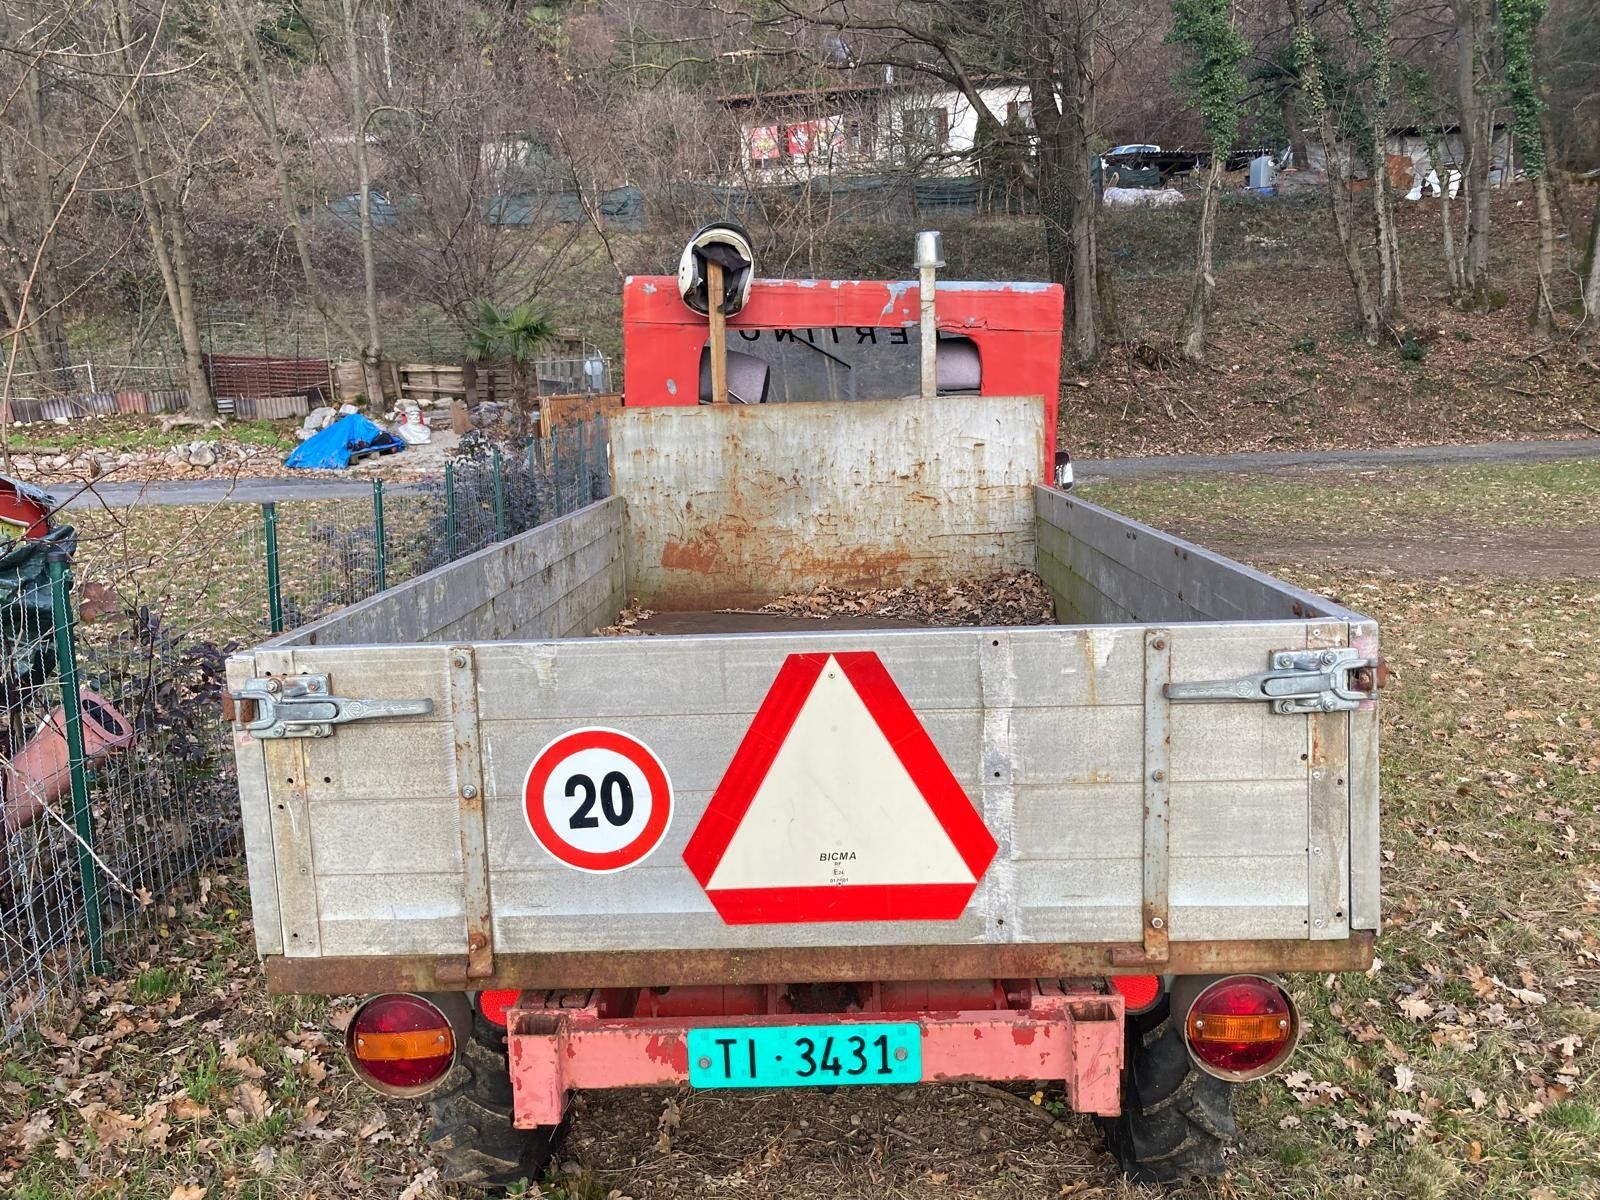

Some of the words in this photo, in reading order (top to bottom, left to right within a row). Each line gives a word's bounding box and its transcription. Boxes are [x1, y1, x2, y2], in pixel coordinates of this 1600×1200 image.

[565, 771, 634, 829] 20
[819, 851, 857, 861] BICMA
[795, 1034, 893, 1078] 3431
